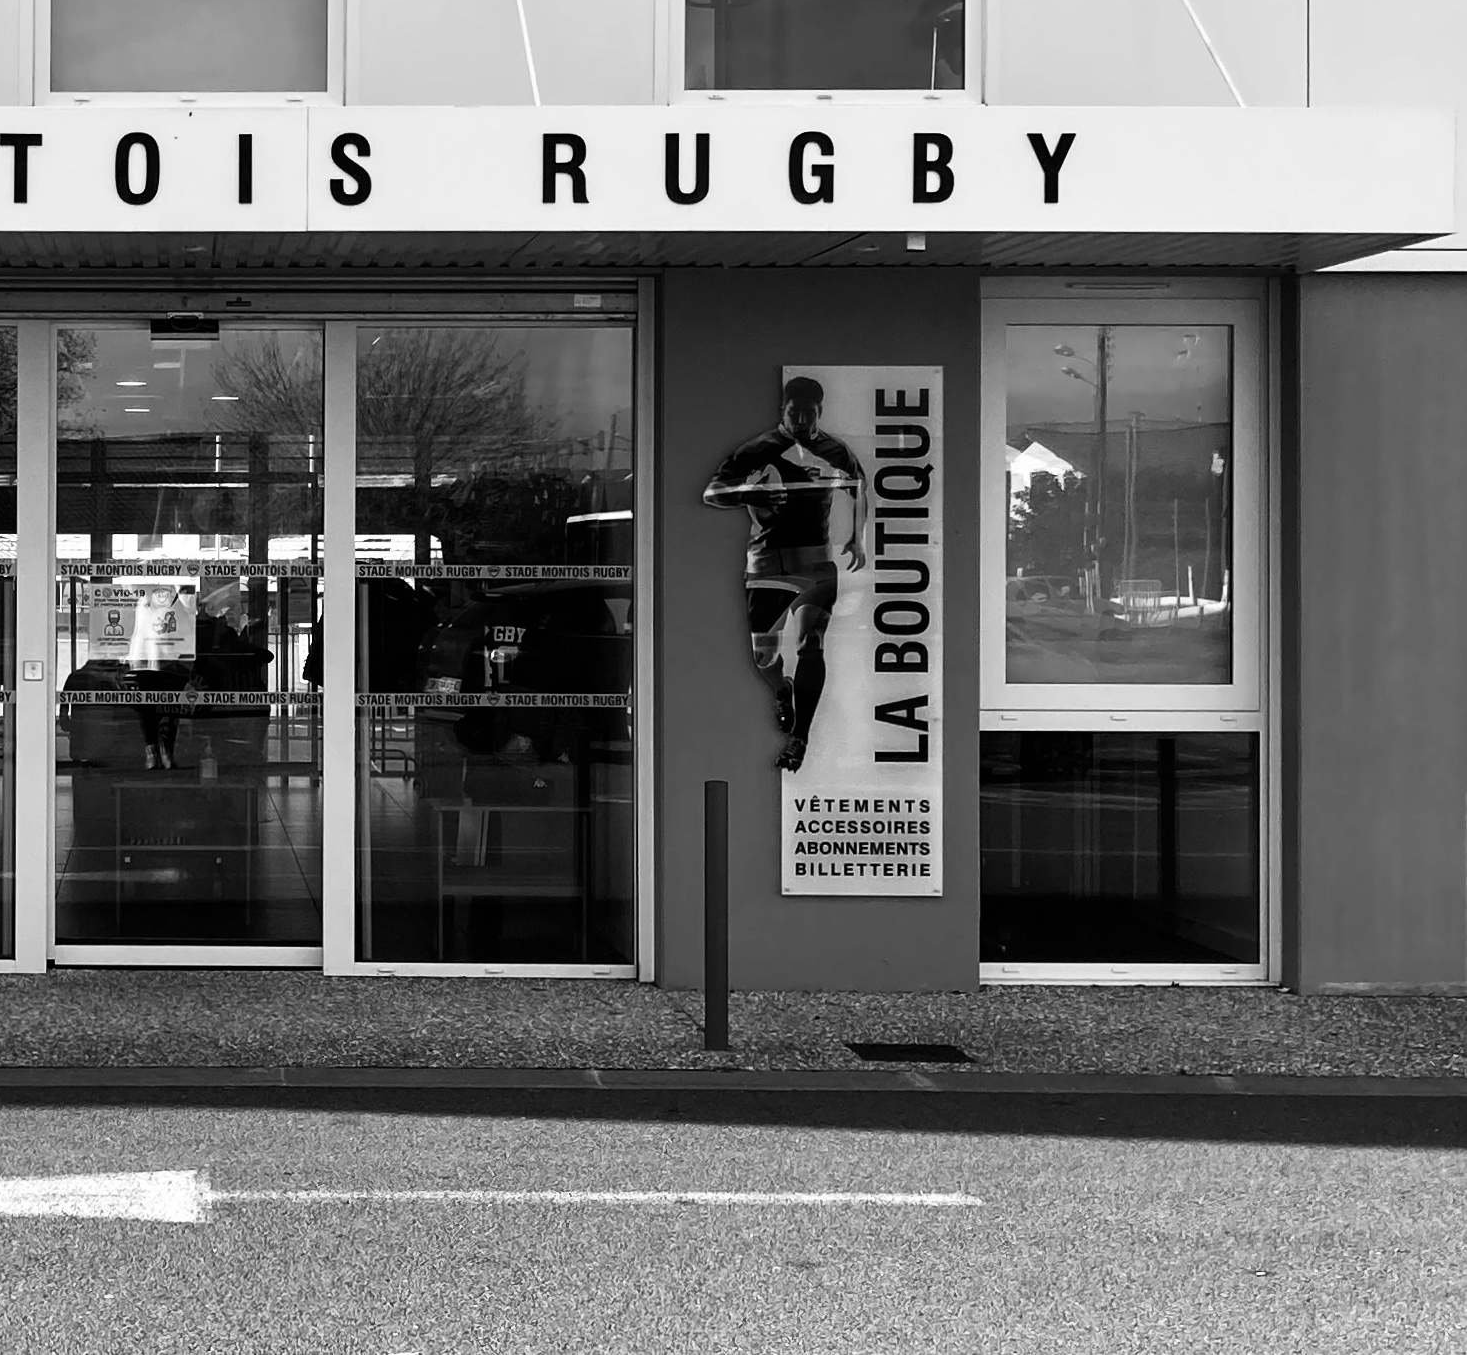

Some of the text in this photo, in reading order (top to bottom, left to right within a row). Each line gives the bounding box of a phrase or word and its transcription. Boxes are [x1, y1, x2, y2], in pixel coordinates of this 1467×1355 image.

[542, 130, 1077, 206] RUGBY
[61, 564, 92, 575] STADE
[96, 564, 143, 576] MONTOIS
[146, 565, 182, 576] RUGBY
[204, 565, 237, 576] STADE
[240, 565, 287, 576] MONTOIS
[358, 566, 392, 576] STADE
[395, 566, 443, 577] MONTOIS
[446, 566, 482, 577] RUGBY
[505, 566, 538, 577] STADE
[541, 567, 590, 578] MONTOIS
[593, 567, 630, 578] RUGBY
[874, 388, 936, 763] LA BOUTIQUE
[60, 692, 92, 703] STADE
[95, 692, 142, 703] MONTOIS
[145, 692, 181, 703] RUGBY
[203, 693, 235, 704] STADE
[238, 693, 286, 704] MONTOIS
[358, 694, 391, 705] STADE
[394, 695, 442, 705] MONTOIS
[446, 695, 482, 706] RUGBY
[505, 695, 538, 705] STADE
[541, 695, 590, 706] MONTOIS
[593, 695, 629, 706] RUGBY
[794, 795, 931, 814] VÊTEMENTS
[794, 820, 931, 835] ACCESSOIRES
[794, 841, 931, 856] ABONNEMENTS
[795, 862, 931, 877] BILLETTERIE
